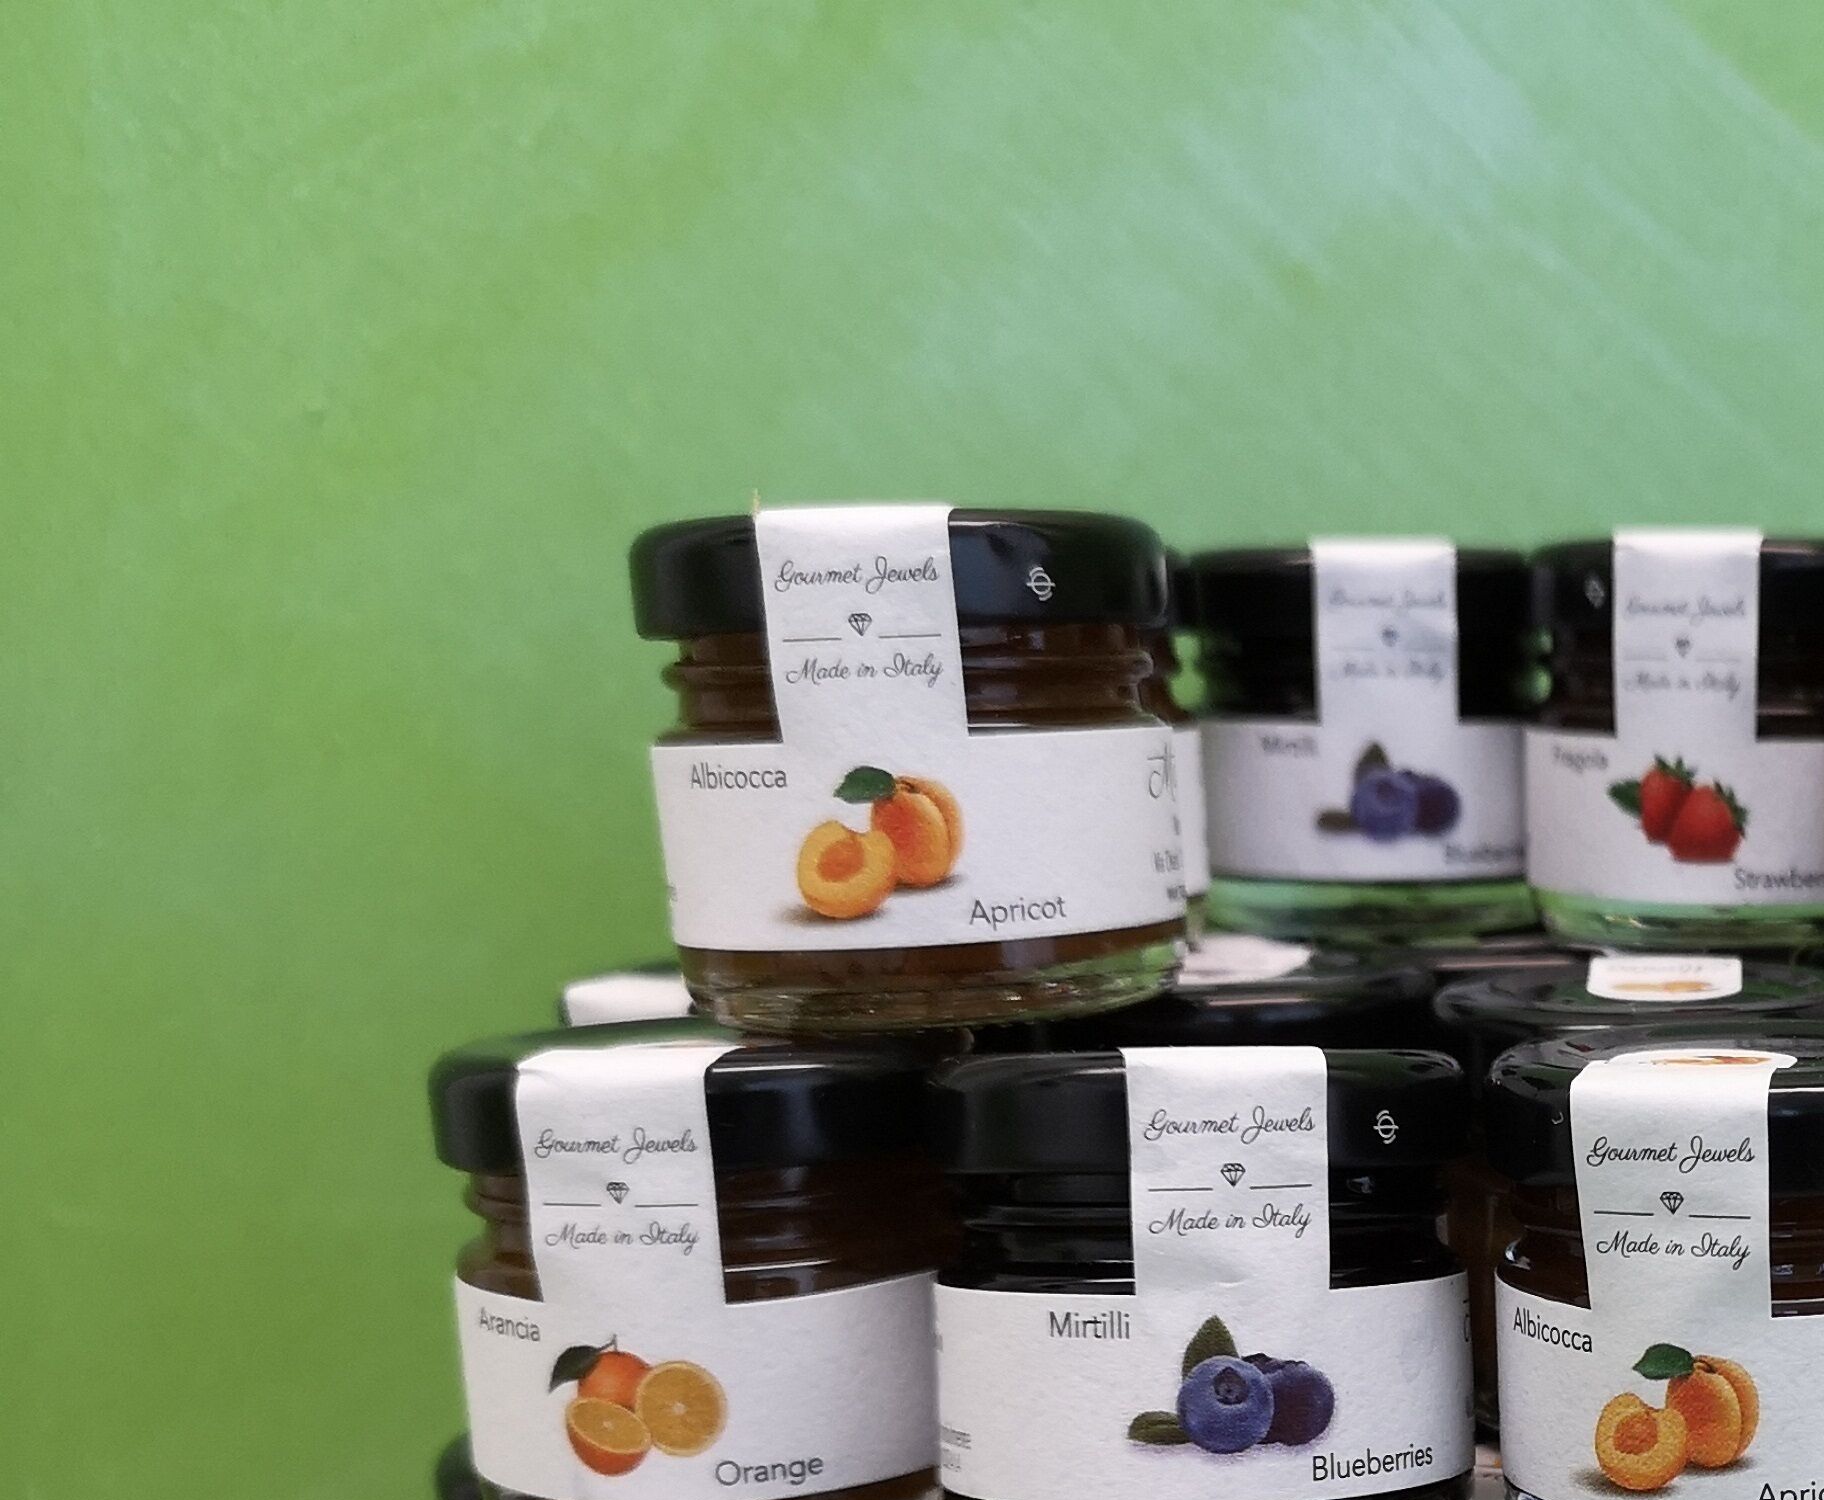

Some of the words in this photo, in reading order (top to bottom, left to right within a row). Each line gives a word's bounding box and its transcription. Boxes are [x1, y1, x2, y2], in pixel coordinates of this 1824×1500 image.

[775, 560, 863, 592] Gourmet
[866, 556, 939, 593] Jewels
[785, 654, 850, 686] Made
[855, 661, 877, 679] in
[883, 651, 943, 687] Italy
[689, 763, 788, 790] Albicocca
[969, 896, 1067, 931] Apricot
[1144, 1109, 1239, 1141] Gourmet
[1241, 1106, 1316, 1144] Jewels
[534, 1128, 620, 1158] Gourmet
[622, 1127, 698, 1165] Jewels
[1586, 1136, 1677, 1166] Gourmet
[1679, 1135, 1755, 1173] Jewels
[545, 1223, 608, 1247] Made
[613, 1229, 634, 1246] in
[638, 1221, 700, 1256] Italy
[1148, 1207, 1219, 1236] Made
[1224, 1213, 1247, 1230] in
[1252, 1202, 1312, 1239] Italy
[1596, 1232, 1660, 1258] Made
[1665, 1239, 1685, 1257] in
[1690, 1231, 1751, 1270] Italy
[478, 1306, 541, 1343] Arancia
[1049, 1311, 1131, 1340] Mirtilli
[1513, 1307, 1593, 1353] Albicocca
[715, 1455, 824, 1487] Orange
[1312, 1443, 1434, 1483] Blueberries
